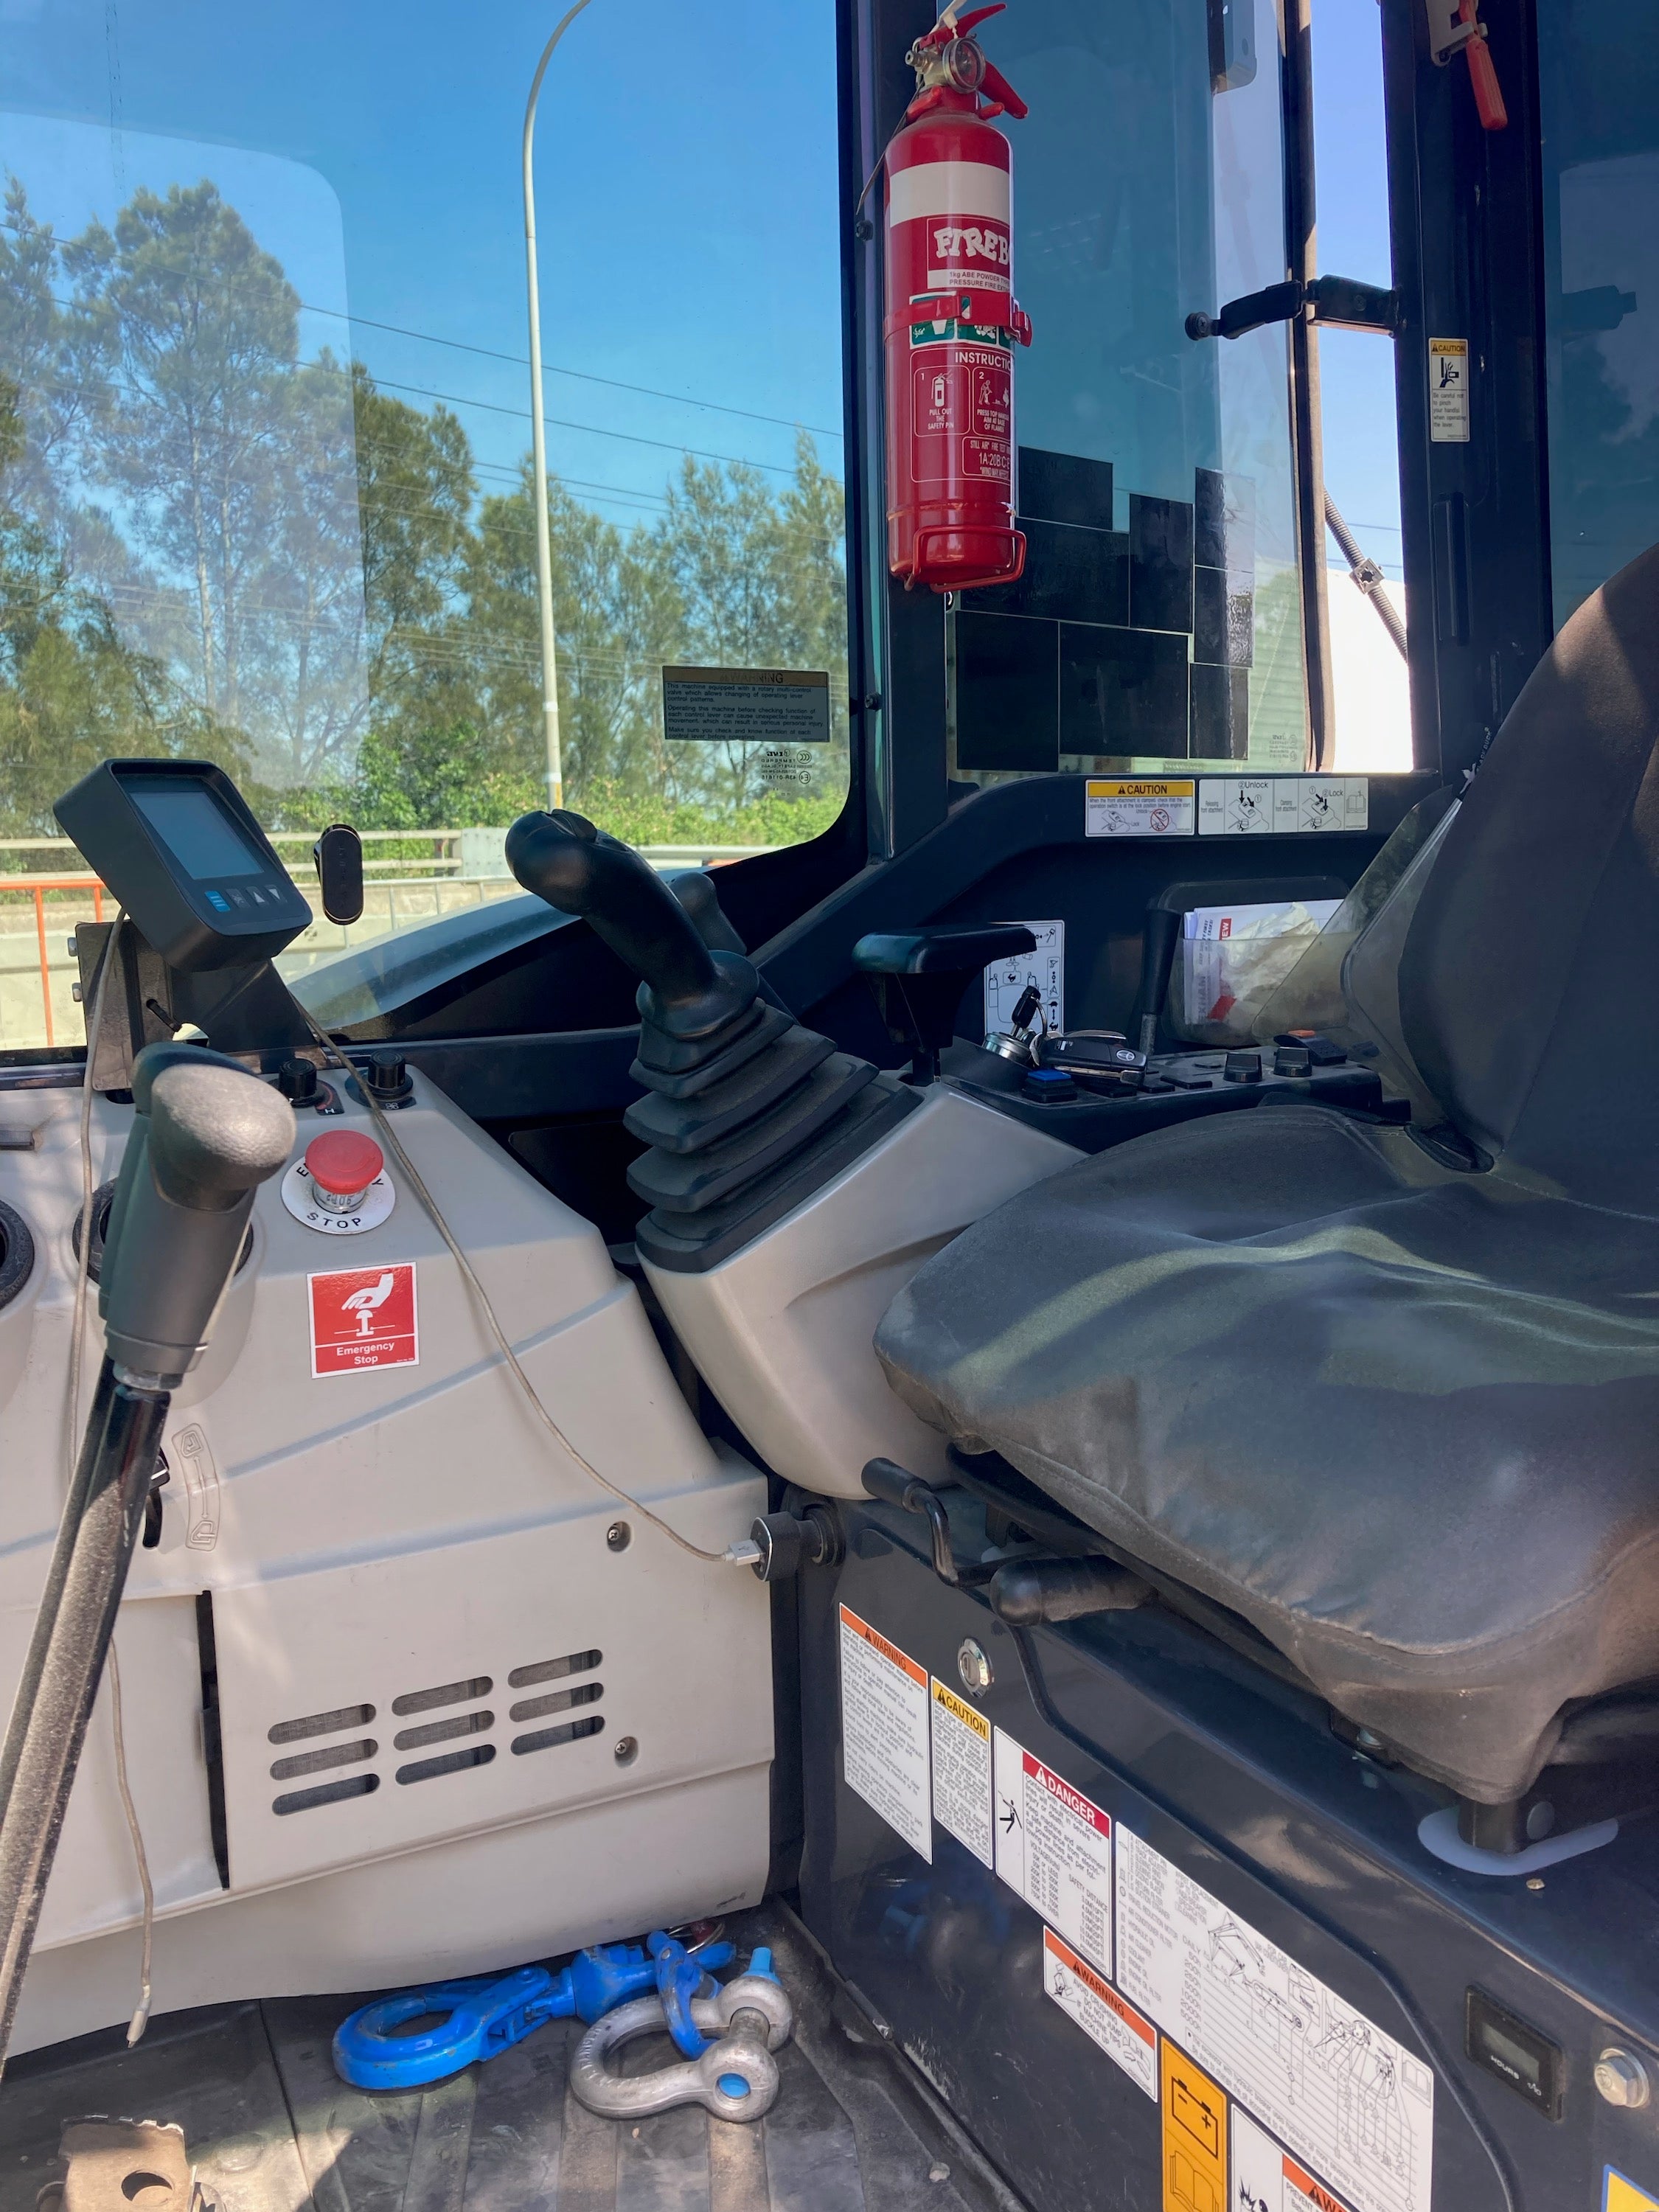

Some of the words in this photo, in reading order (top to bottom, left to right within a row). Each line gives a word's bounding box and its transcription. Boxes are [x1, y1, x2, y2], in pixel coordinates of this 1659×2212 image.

[933, 226, 1010, 265] FIREB
[976, 273, 1000, 281] POWDER
[730, 672, 784, 684] WARNING
[1127, 785, 1167, 795] CAUTION
[1221, 922, 1230, 939] EW
[307, 1212, 361, 1228] STOP
[336, 1342, 395, 1356] Emergency
[354, 1355, 378, 1365] Stop
[872, 1635, 906, 1669] WARNING
[946, 1694, 986, 1736] CAUTION
[1048, 1775, 1094, 1825] DANGER
[1182, 1935, 1200, 1955] DAILY
[1073, 1978, 1088, 1996] AVOID
[1081, 1968, 1124, 2015] WARNING
[1079, 2012, 1099, 2036] BUCKLE
[1102, 2034, 1109, 2045] UP
[1083, 2007, 1107, 2034] MACHINE
[1109, 2031, 1121, 2048] TIPS
[1084, 1997, 1091, 2008] DO
[1093, 2006, 1104, 2020] NOT
[1106, 2020, 1121, 2038] JUMP
[1490, 2055, 1520, 2080] HOURS
